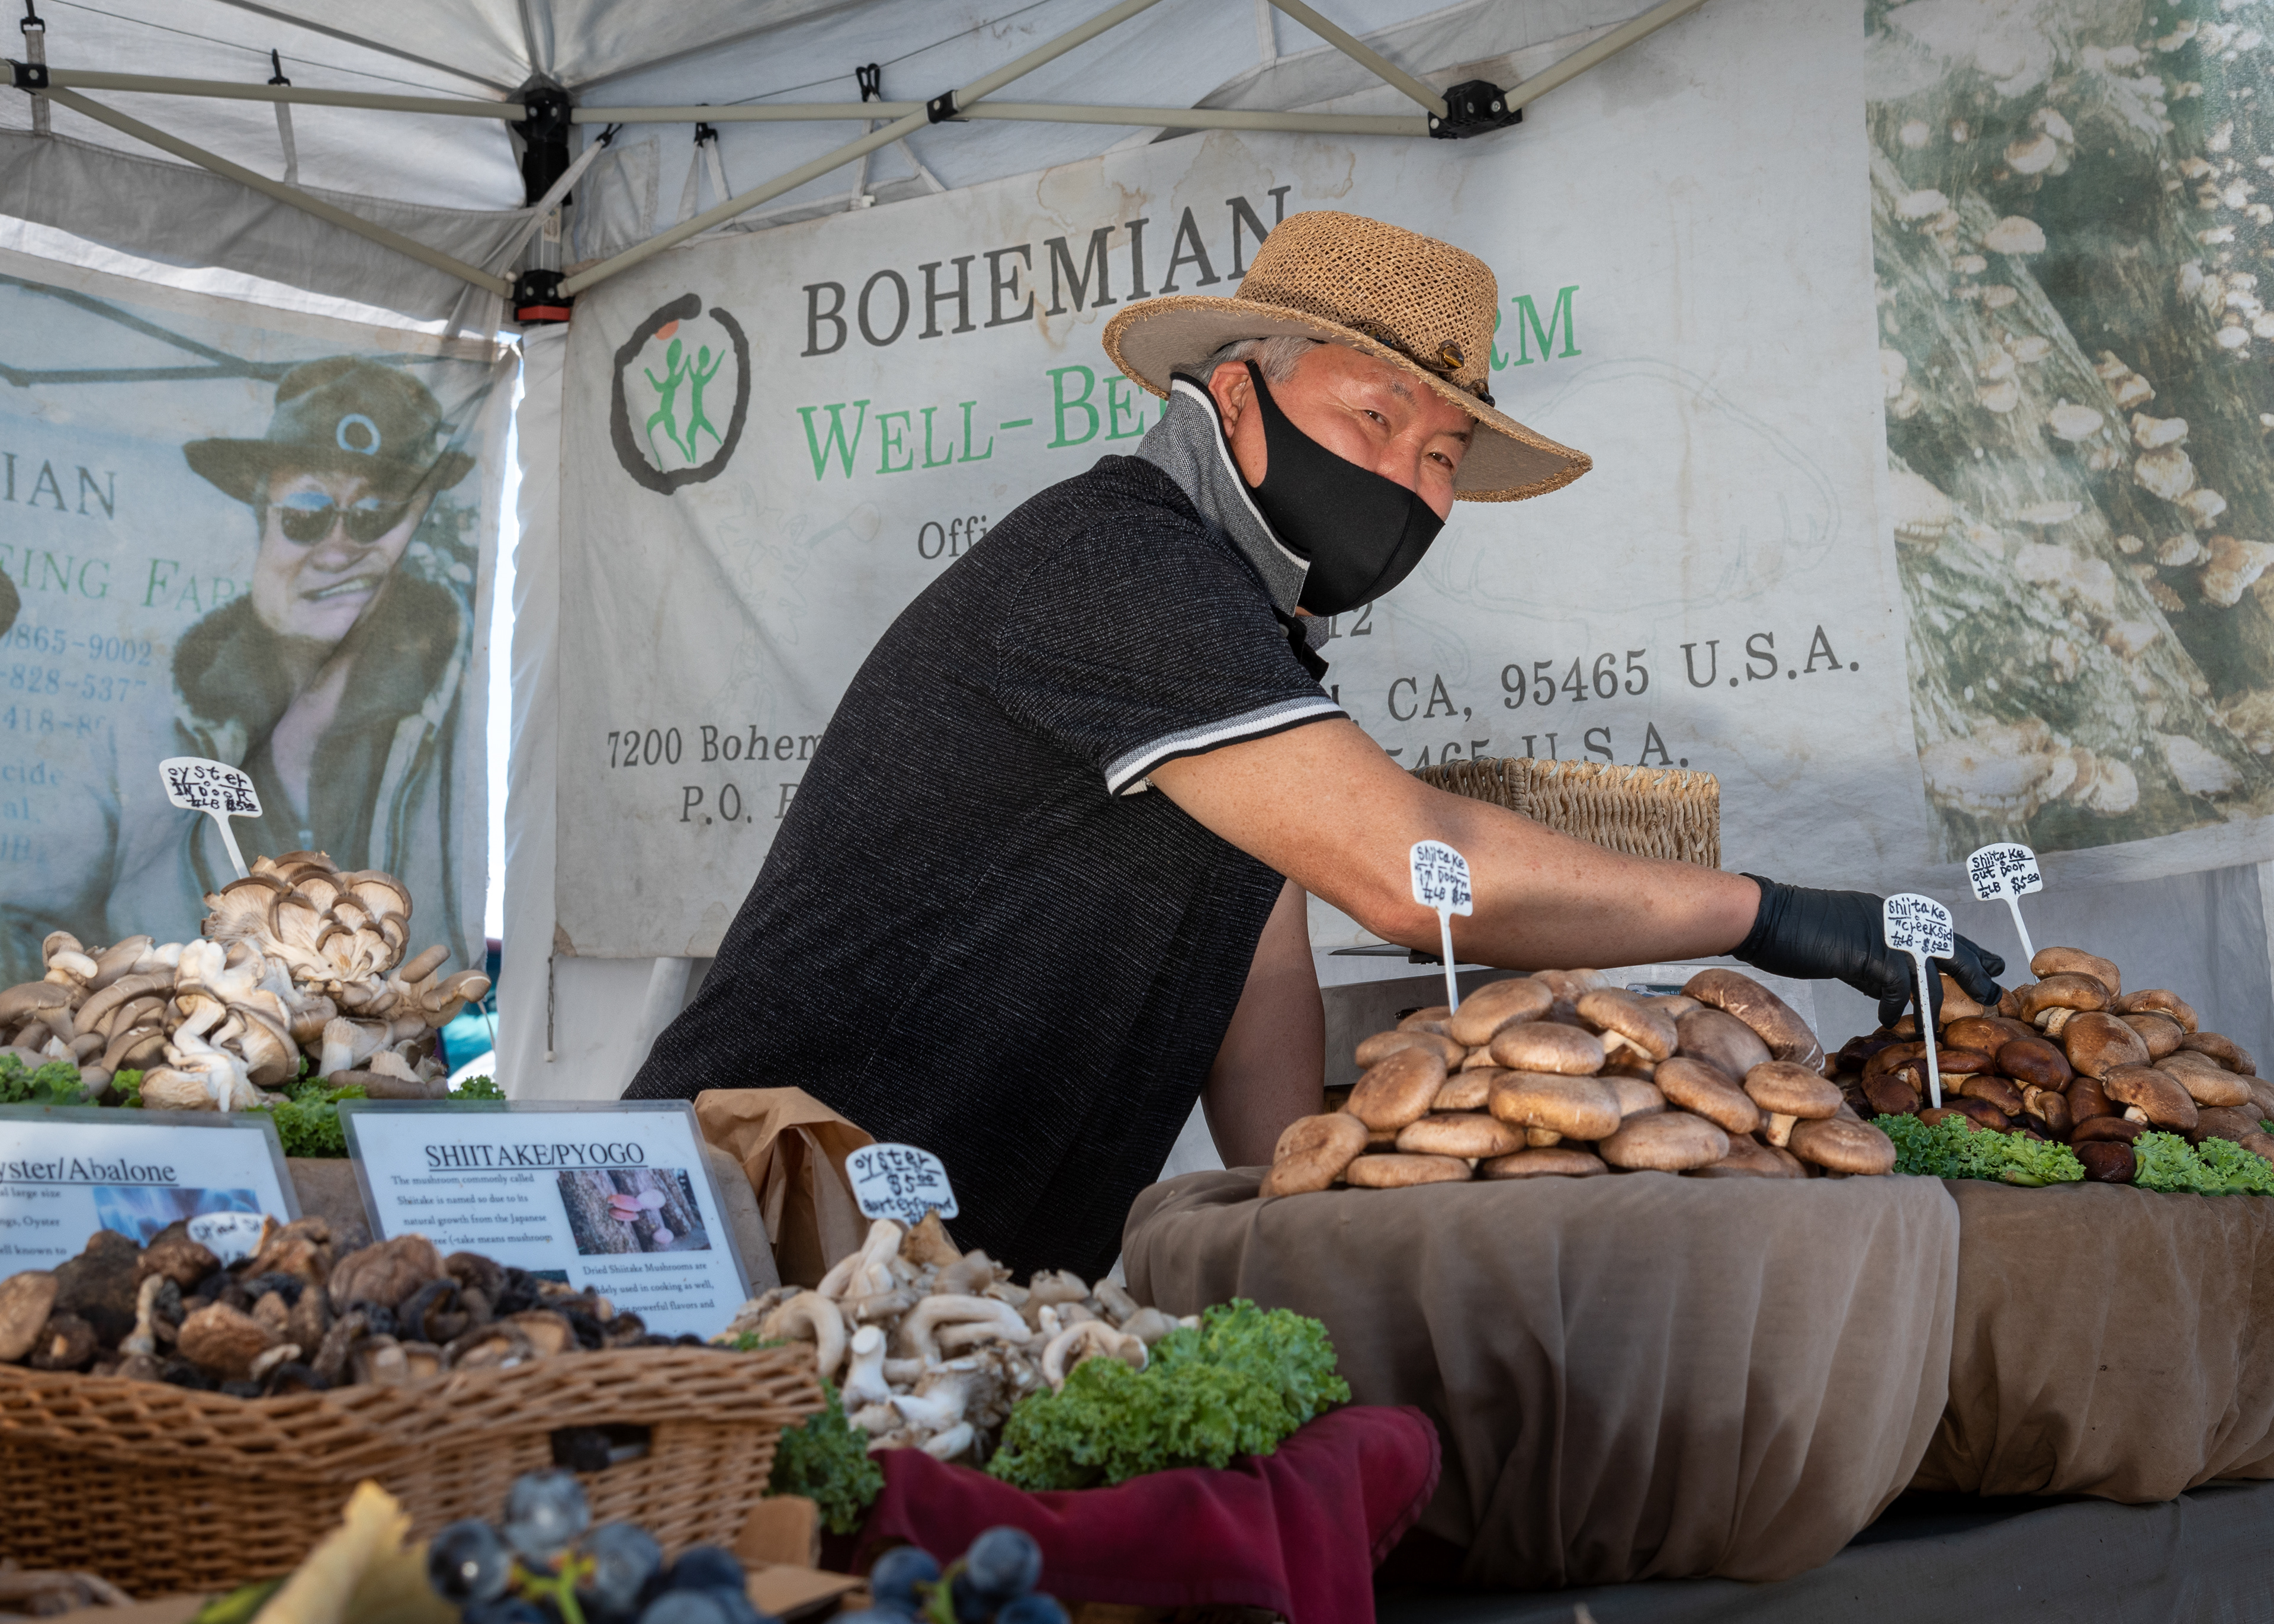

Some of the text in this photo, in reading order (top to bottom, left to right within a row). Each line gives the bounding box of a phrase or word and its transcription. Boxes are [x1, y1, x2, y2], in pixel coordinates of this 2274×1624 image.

[801, 185, 1292, 358] BOHEMIAN
[608, 727, 682, 768] 7200
[1387, 673, 1472, 722] CA,
[1501, 648, 1649, 710] 95465
[1679, 624, 1860, 689] U.S.A.
[679, 783, 752, 825] P.O.
[391, 1173, 534, 1185] The mushroom commonly called
[447, 1194, 474, 1204] named
[490, 1193, 504, 1203] due
[506, 1195, 515, 1203] to
[403, 1213, 547, 1227] natural growth from the Japanese
[508, 1232, 553, 1243] mushroom
[583, 1265, 608, 1275] Dried
[644, 1262, 693, 1273] Mushrooms
[596, 1285, 617, 1295] idely
[619, 1284, 638, 1293] used
[640, 1282, 649, 1292] in
[651, 1281, 683, 1292] cooking
[670, 1300, 698, 1310] flavors
[700, 1298, 715, 1308] and
